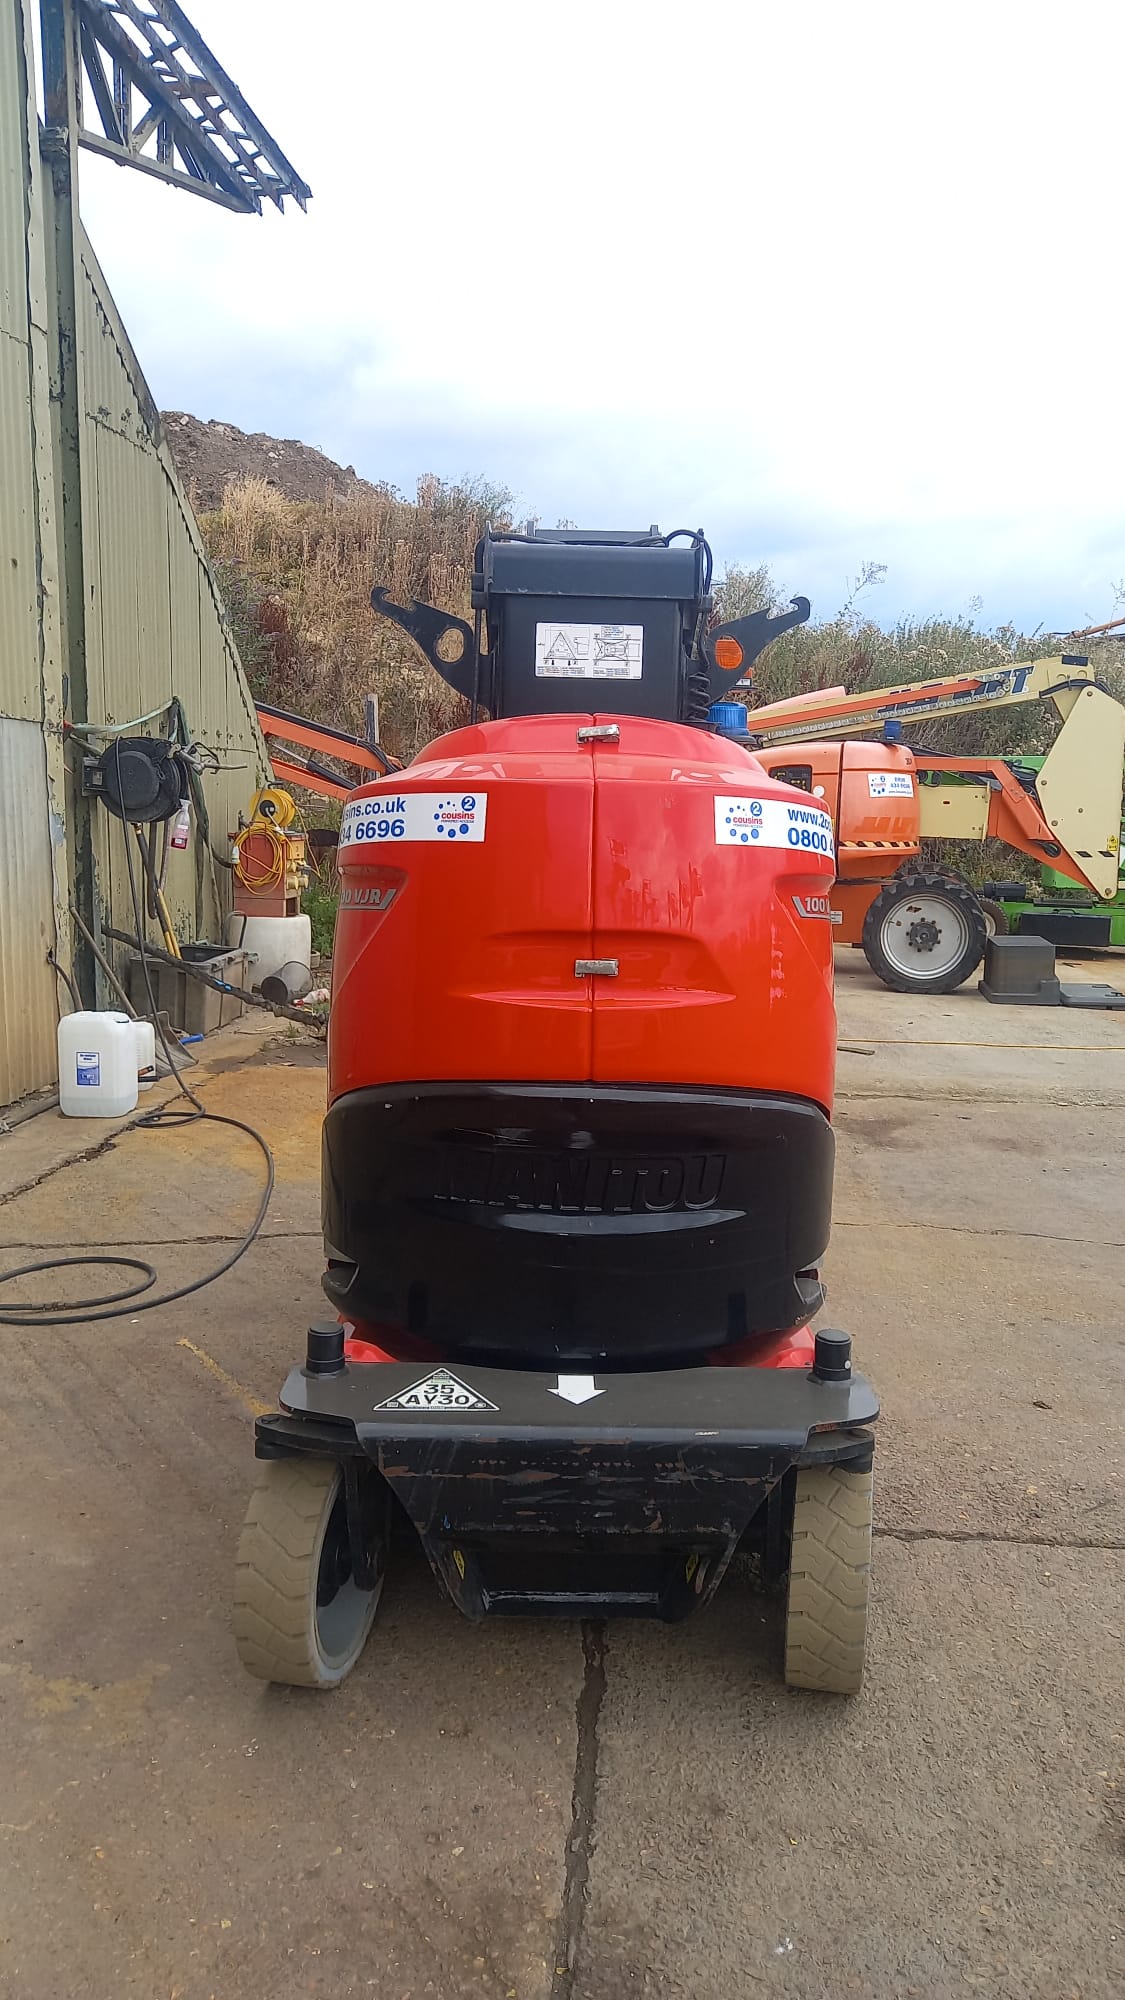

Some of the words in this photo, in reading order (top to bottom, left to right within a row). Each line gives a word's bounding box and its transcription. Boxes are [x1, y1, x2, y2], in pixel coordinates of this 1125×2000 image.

[343, 797, 406, 820] sins.co.uk
[441, 811, 474, 820] cousins
[732, 816, 762, 824] cousins
[356, 819, 404, 840] 6696
[788, 828, 828, 851] 0800
[354, 888, 381, 904] VJR
[805, 896, 825, 912] 100
[424, 1384, 455, 1394] 35
